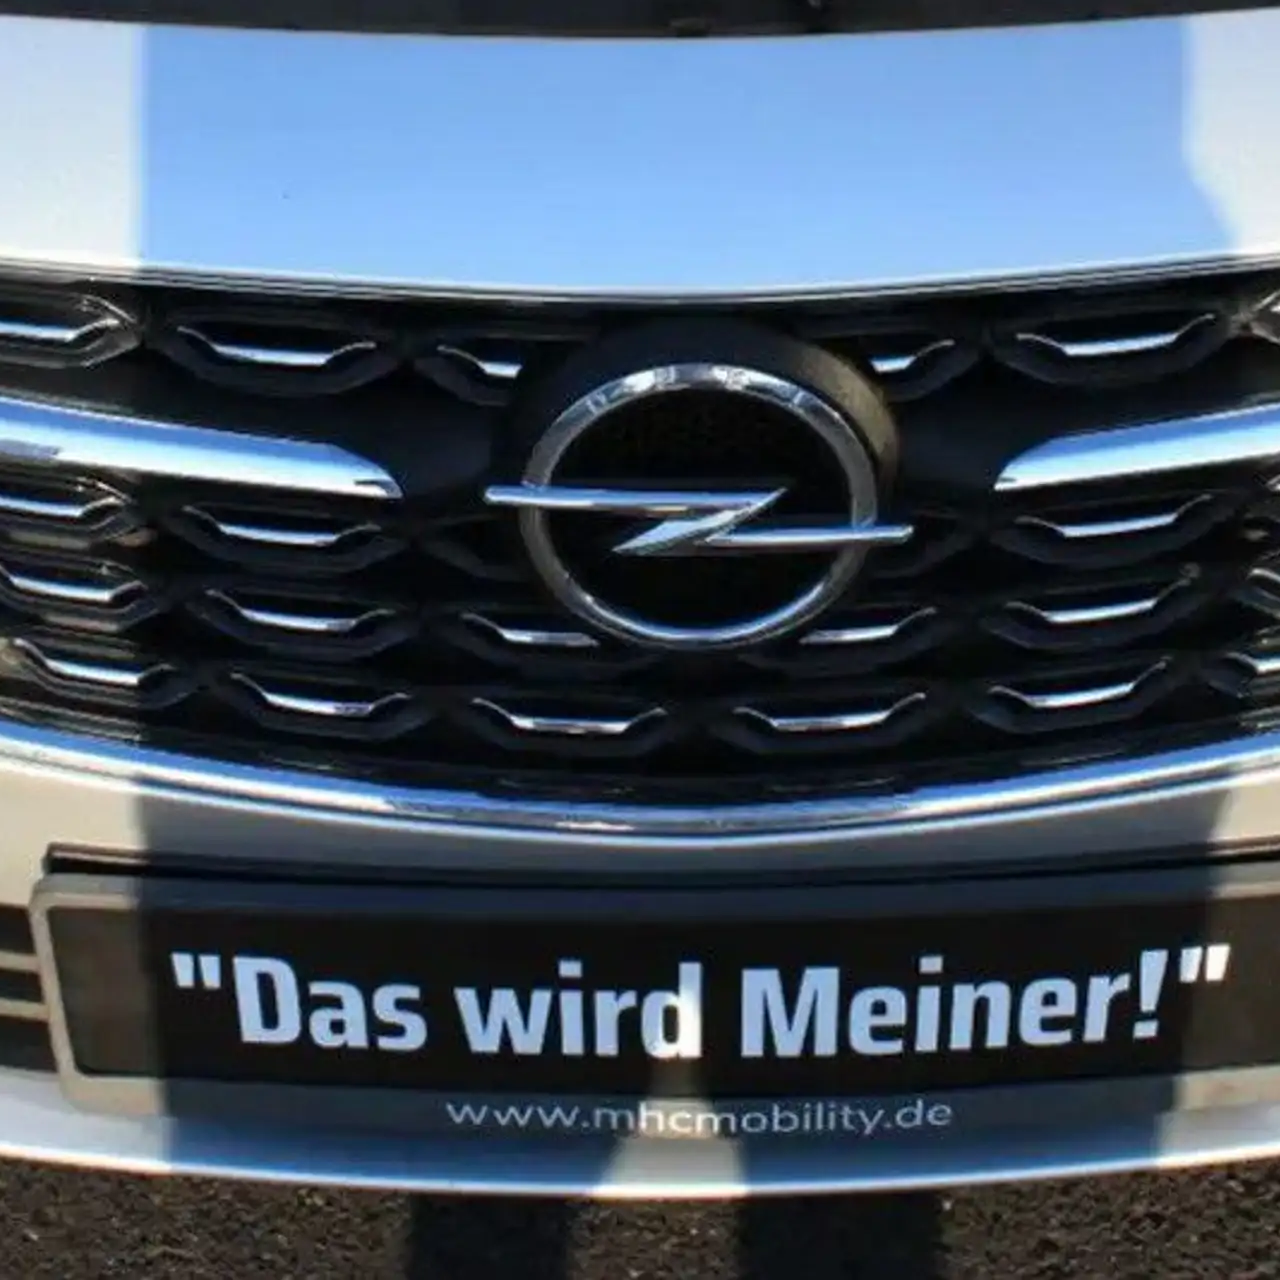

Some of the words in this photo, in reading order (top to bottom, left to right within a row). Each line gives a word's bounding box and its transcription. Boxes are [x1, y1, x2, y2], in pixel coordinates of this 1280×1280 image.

[170, 951, 428, 1052] "Das
[453, 959, 703, 1059] wird
[740, 944, 1231, 1058] Meiner!"
[445, 1099, 954, 1136] www.mhcmobility.de
